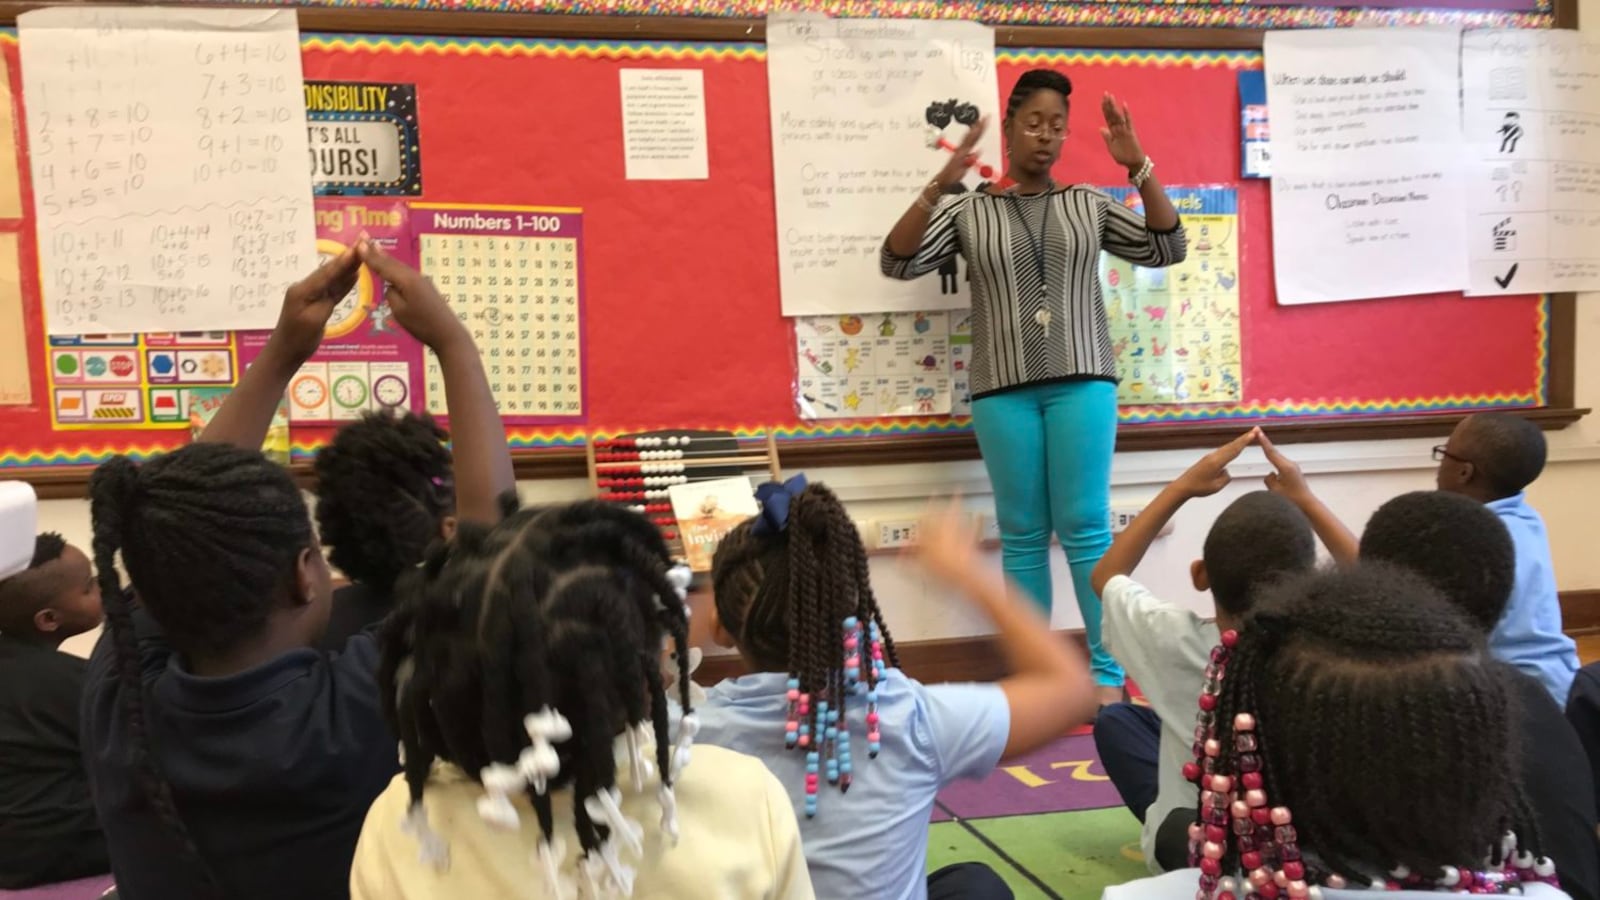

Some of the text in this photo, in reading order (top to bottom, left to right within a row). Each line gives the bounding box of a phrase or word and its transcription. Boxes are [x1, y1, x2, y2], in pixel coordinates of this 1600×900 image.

[335, 127, 362, 144] ALL
[345, 205, 401, 227] Time
[433, 213, 511, 232] Numbers
